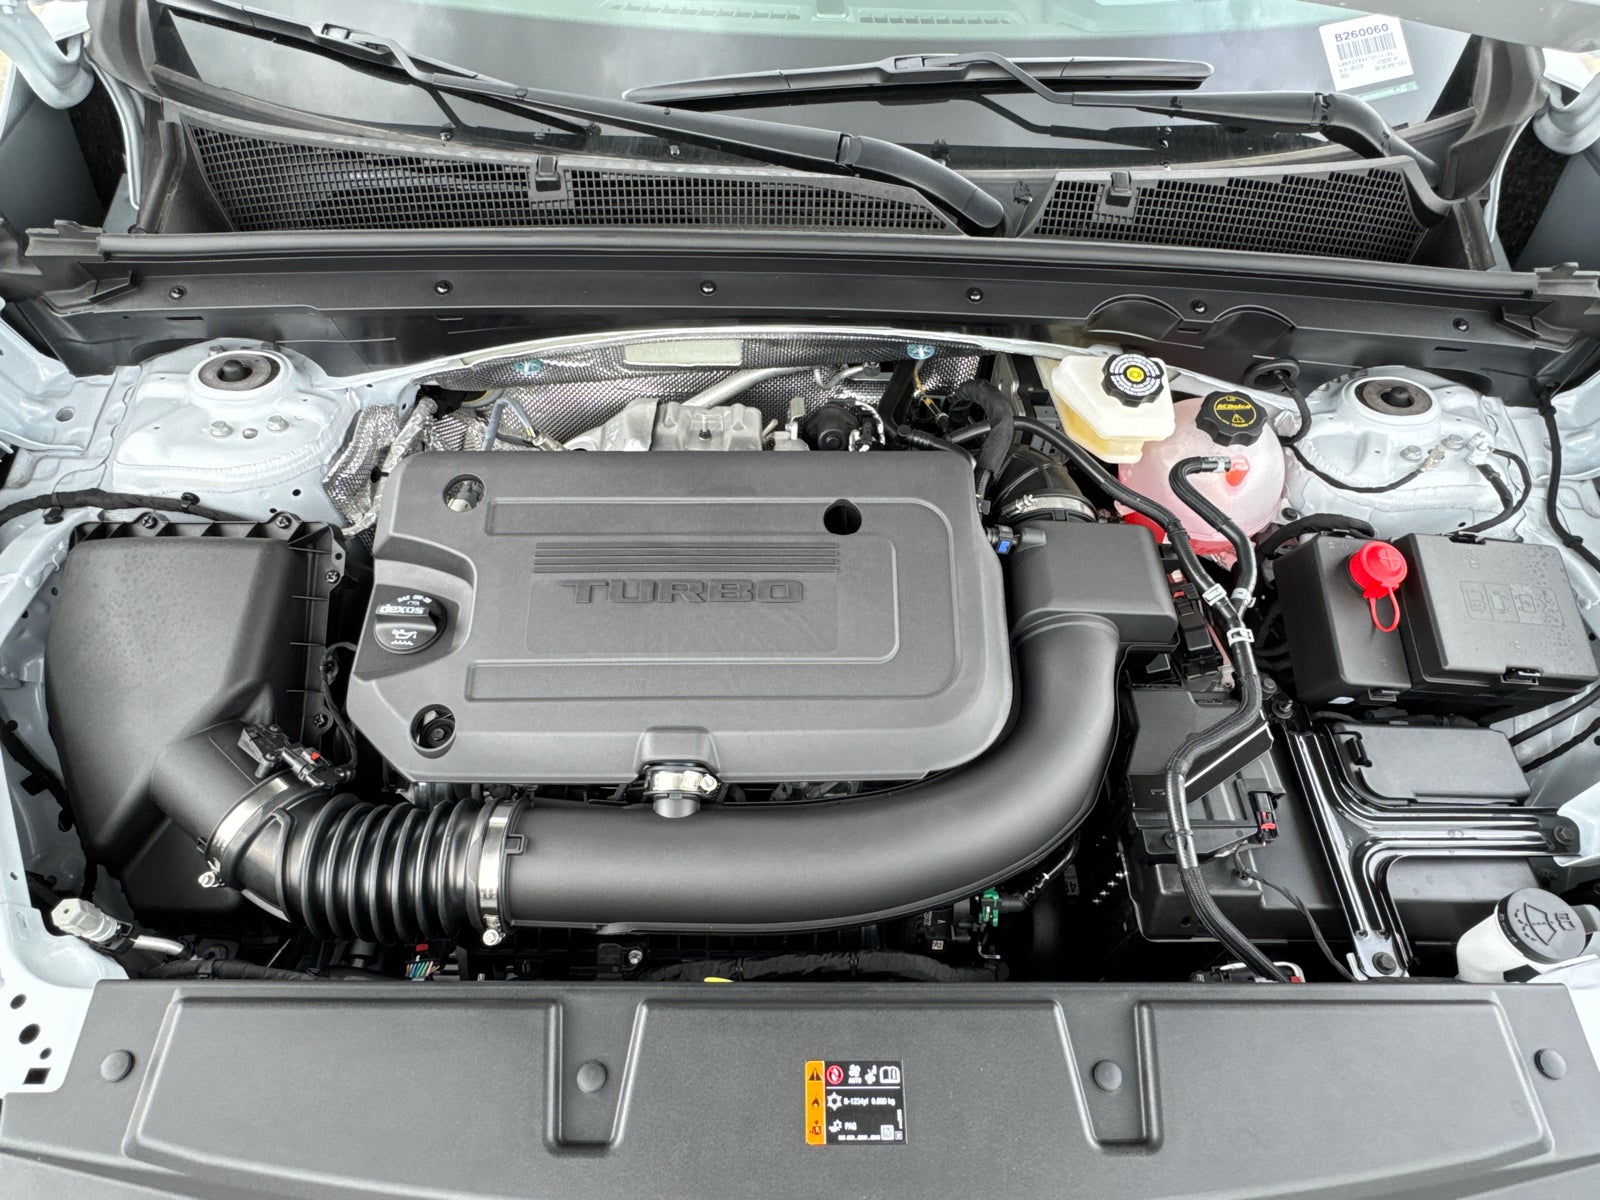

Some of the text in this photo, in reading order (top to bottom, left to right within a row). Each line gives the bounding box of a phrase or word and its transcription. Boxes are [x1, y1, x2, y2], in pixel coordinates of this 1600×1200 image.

[1334, 23, 1389, 43] B260060
[560, 578, 804, 604] TURBO
[379, 603, 426, 615] dexos
